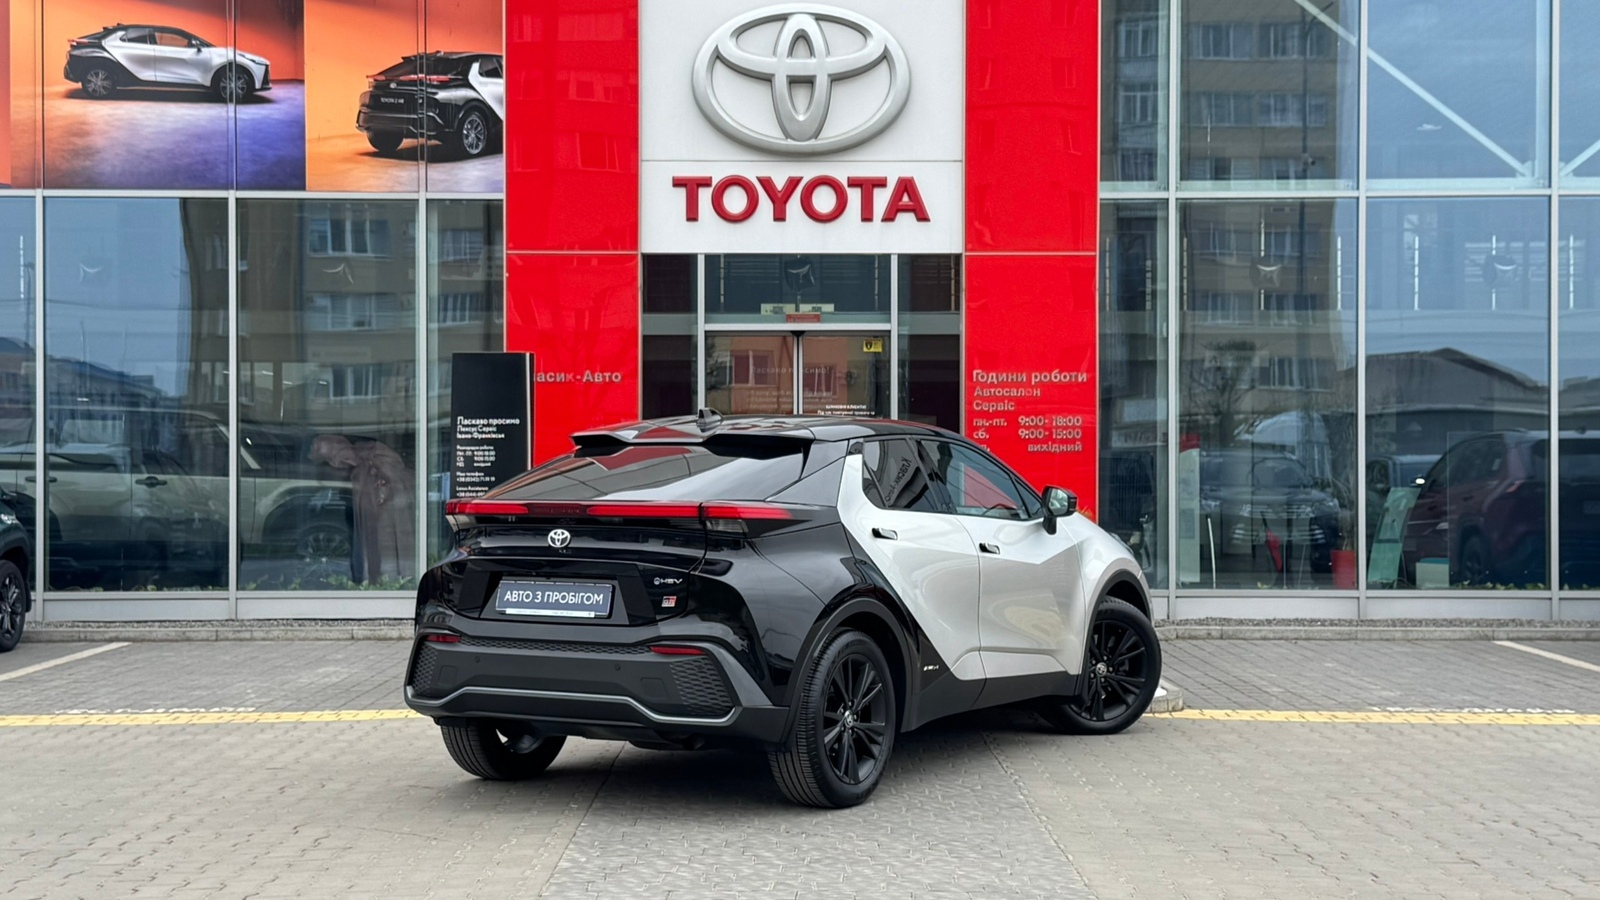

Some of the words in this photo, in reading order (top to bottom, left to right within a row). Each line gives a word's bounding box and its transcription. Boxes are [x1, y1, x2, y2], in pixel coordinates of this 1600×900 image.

[672, 175, 931, 223] TOYOTA
[534, 369, 621, 382] асик-Авто
[973, 370, 1026, 384] Години
[1031, 369, 1087, 385] роботи
[974, 387, 1041, 397] Автосалон
[973, 400, 1015, 413] Сервіс
[1027, 441, 1082, 454] вихідний
[504, 590, 533, 602] АВТО
[544, 592, 604, 605] ПРОБІГОМ
